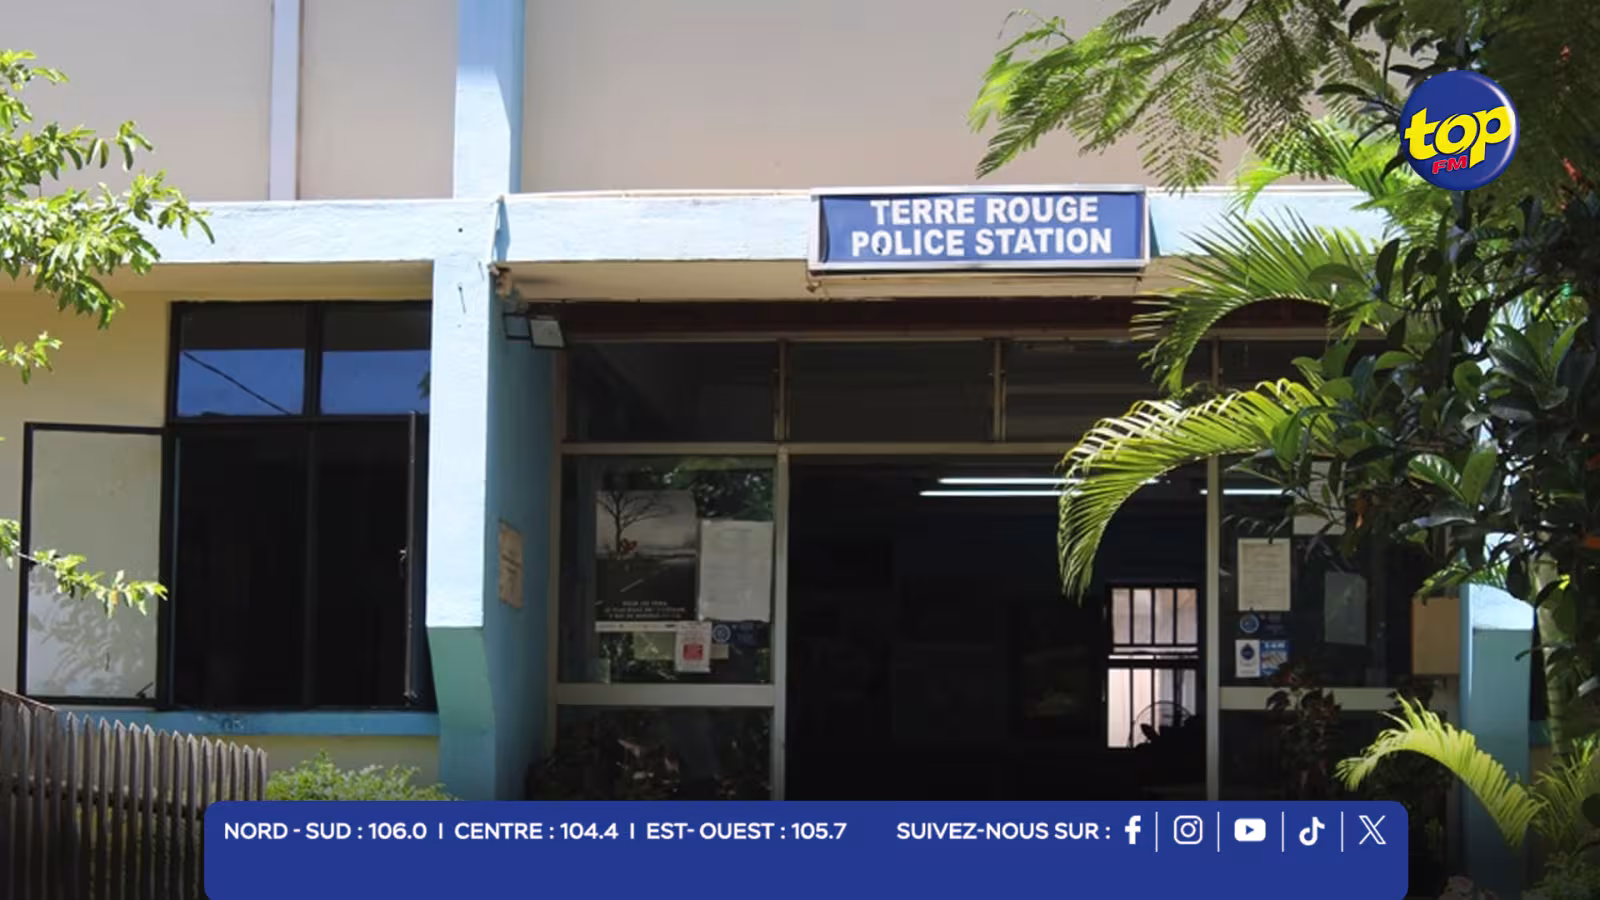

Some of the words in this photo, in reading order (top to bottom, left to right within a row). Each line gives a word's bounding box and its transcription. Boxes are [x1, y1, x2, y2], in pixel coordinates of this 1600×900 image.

[870, 197, 975, 226] TERRE
[986, 195, 1099, 225] ROUGE
[852, 229, 965, 257] POLICE
[975, 227, 1112, 256] STATION
